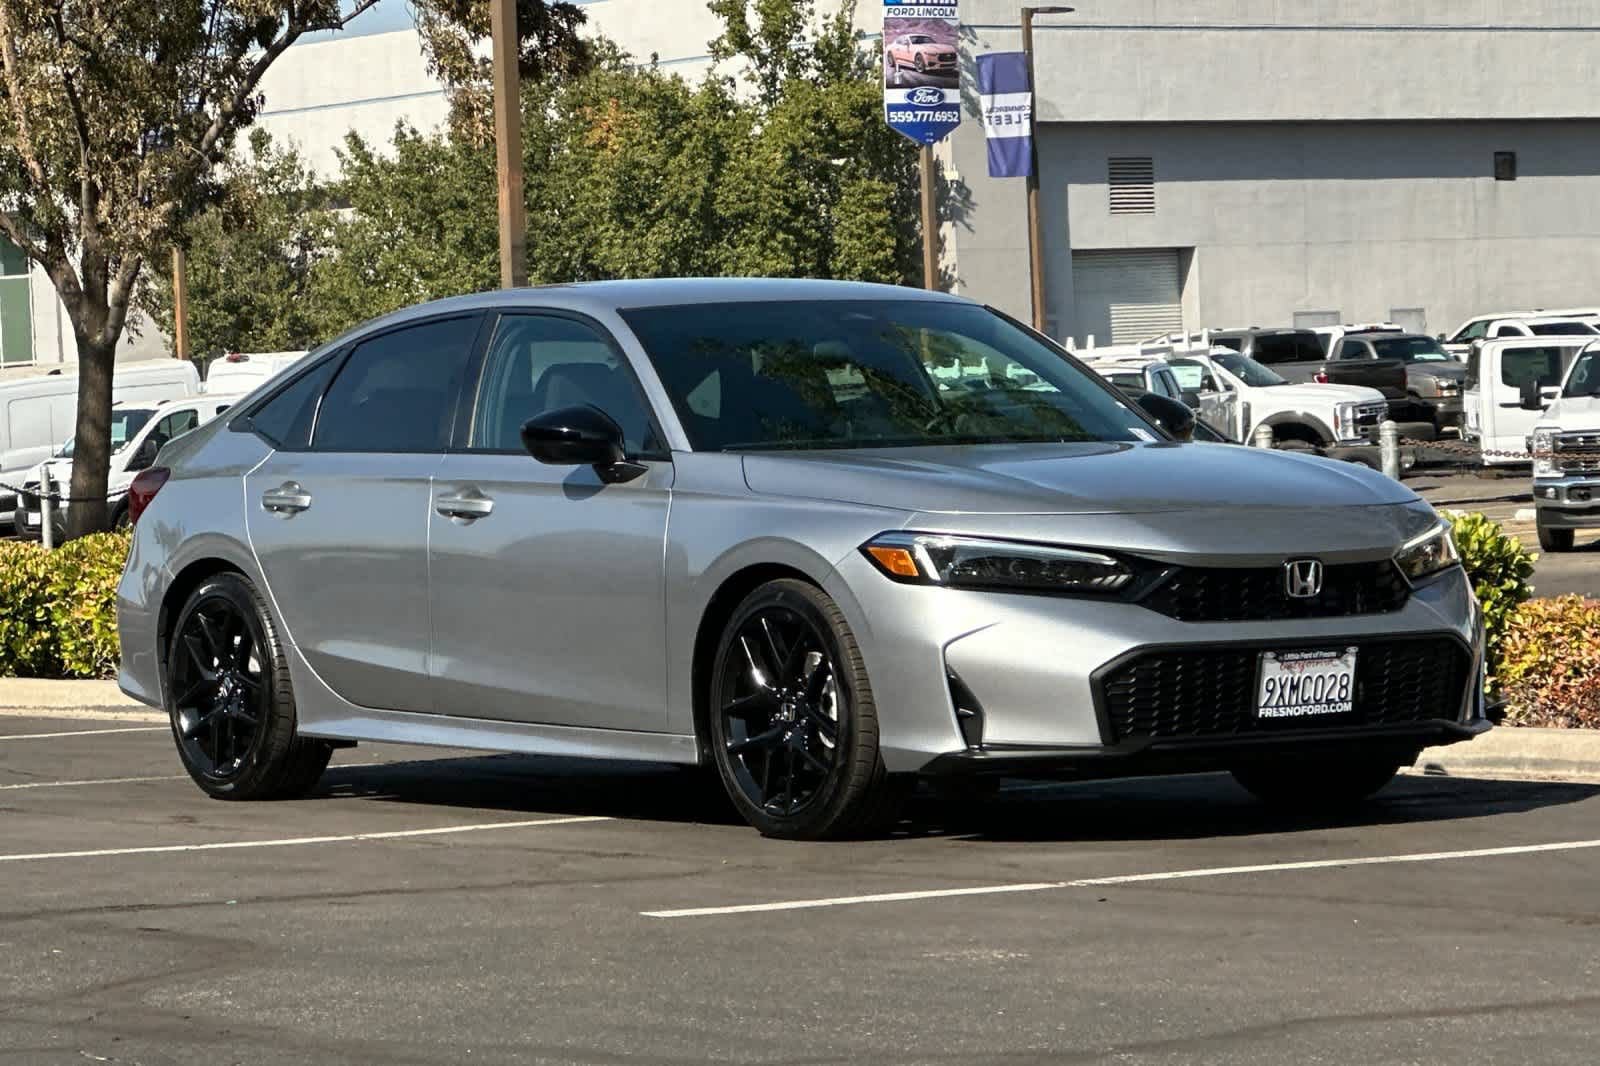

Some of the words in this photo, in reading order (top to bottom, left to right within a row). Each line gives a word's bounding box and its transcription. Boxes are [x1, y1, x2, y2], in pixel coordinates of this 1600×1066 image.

[887, 7, 915, 16] FORD
[917, 7, 956, 17] LINCOLN
[913, 88, 940, 103] Ford
[889, 111, 959, 123] 559.777.6952
[1263, 673, 1350, 707] 9XMC028
[1258, 701, 1353, 718] FRESNOFORD.COM
